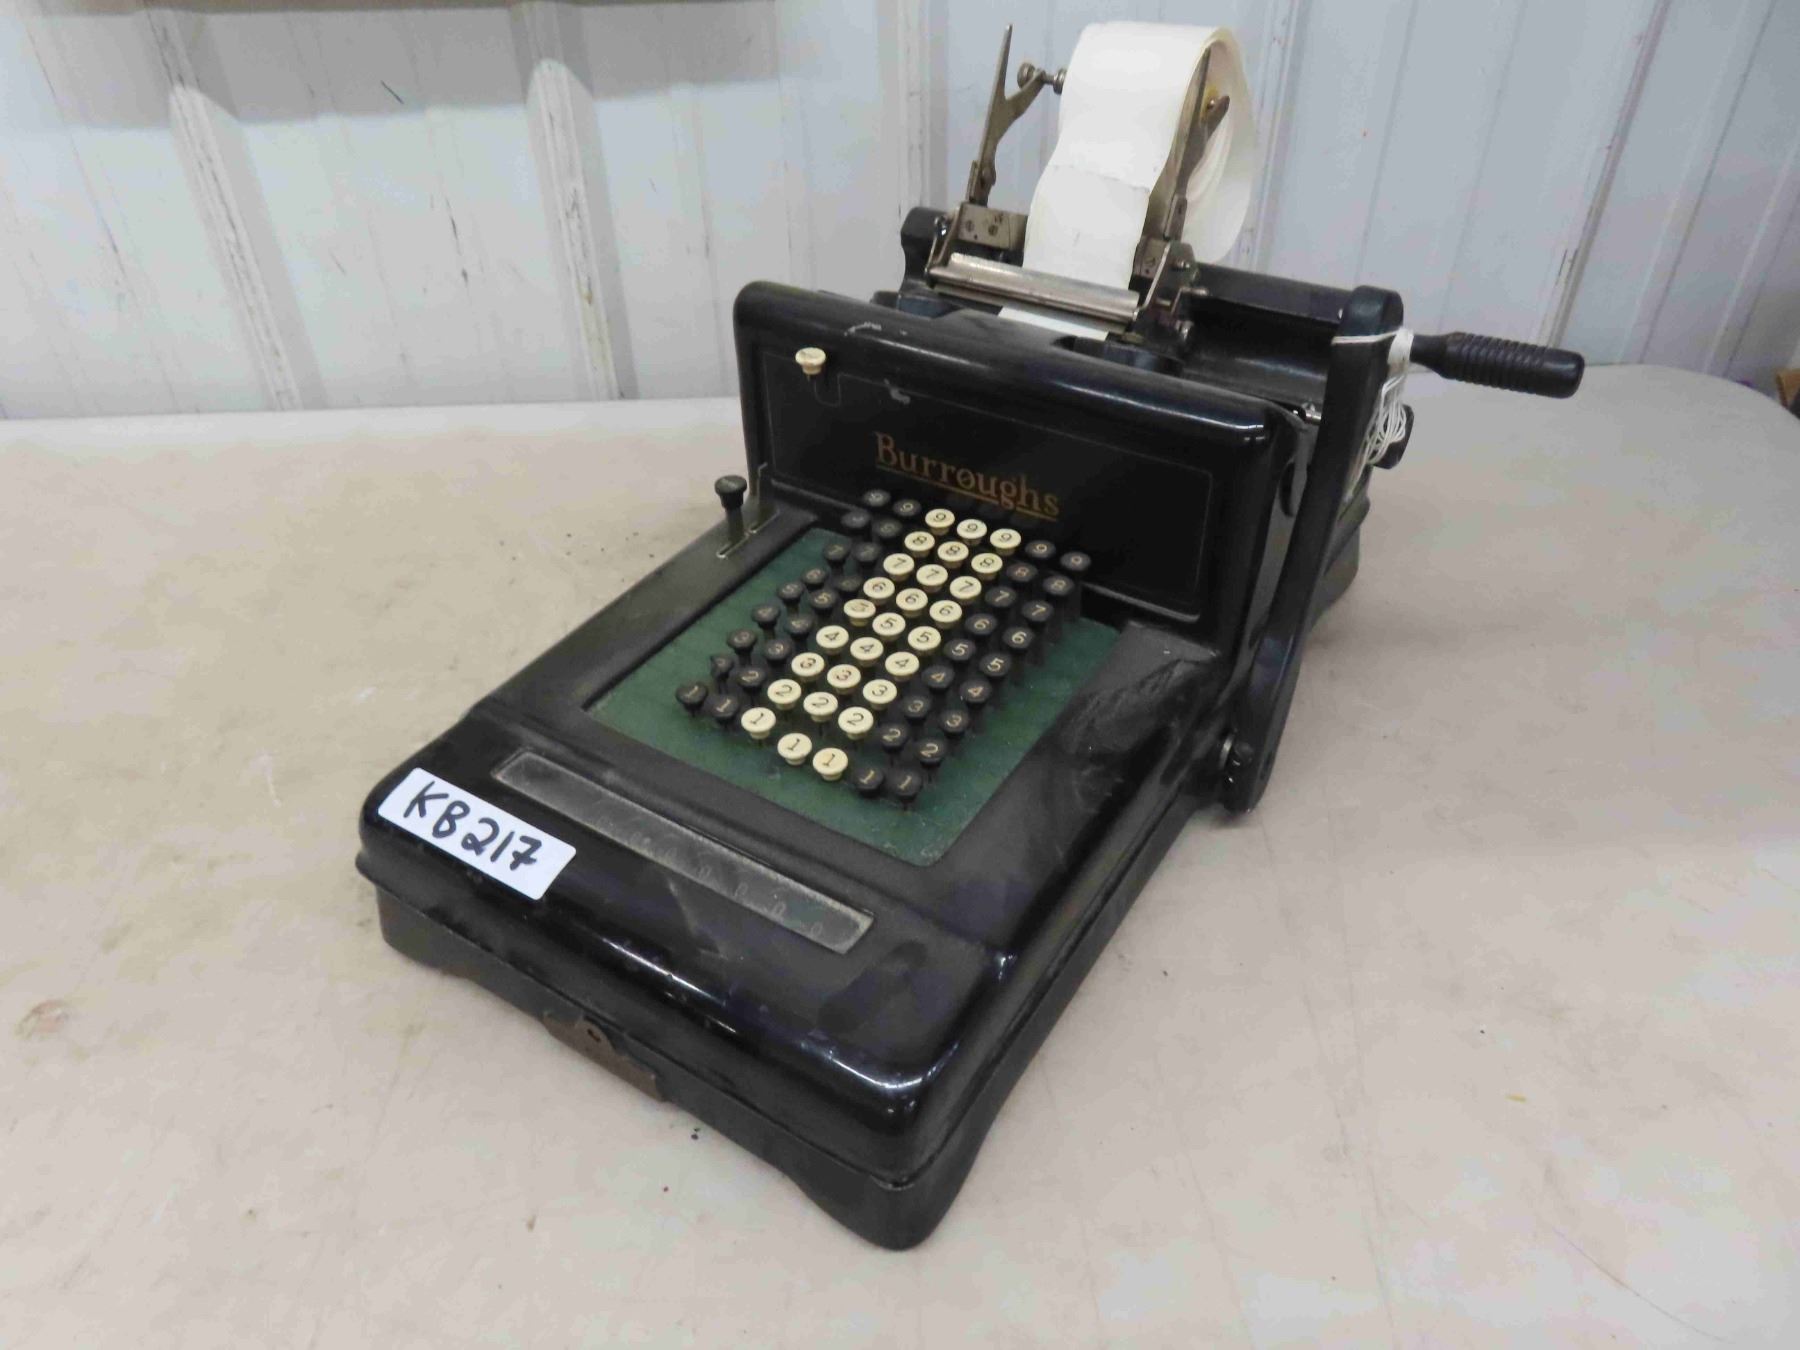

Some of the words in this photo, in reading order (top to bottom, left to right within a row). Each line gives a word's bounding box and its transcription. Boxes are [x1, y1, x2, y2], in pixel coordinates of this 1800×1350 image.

[875, 431, 1059, 516] Burroughs
[933, 512, 946, 523] 9
[967, 523, 979, 533] 9
[912, 535, 927, 545] 8
[1001, 532, 1014, 544] 9
[947, 545, 961, 556] 8
[1034, 543, 1049, 555] 9
[892, 557, 907, 568] 7
[979, 557, 995, 569] 8
[1070, 554, 1083, 566] 9
[925, 568, 940, 579] 7
[1015, 566, 1029, 578] 8
[871, 582, 886, 592] 6
[958, 580, 975, 593] 7
[1052, 579, 1067, 591] 8
[905, 593, 920, 604] 6
[995, 591, 1010, 603] 7
[938, 605, 954, 616] 6
[1032, 604, 1047, 617] 7
[880, 617, 897, 630] 5
[973, 618, 990, 630] 6
[823, 631, 841, 642] 4
[915, 631, 933, 644] 5
[1010, 631, 1028, 644] 6
[859, 642, 875, 653] 4
[951, 643, 969, 657] 5
[799, 657, 817, 669] 3
[895, 657, 910, 668] 4
[987, 657, 1005, 672] 5
[835, 669, 852, 682] 3
[930, 671, 947, 683] 4
[686, 685, 699, 699] 1
[775, 684, 793, 697] 2
[871, 684, 889, 697] 3
[967, 684, 984, 697] 4
[716, 699, 731, 713] 1
[811, 696, 829, 709] 2
[907, 700, 924, 713] 3
[750, 712, 765, 725] 1
[846, 712, 865, 726] 2
[946, 715, 962, 728] 3
[882, 728, 901, 742] 2
[919, 743, 939, 758] 2
[822, 752, 836, 767] 1
[859, 769, 875, 785] 1
[899, 775, 912, 790] 1
[402, 780, 543, 871] KB217
